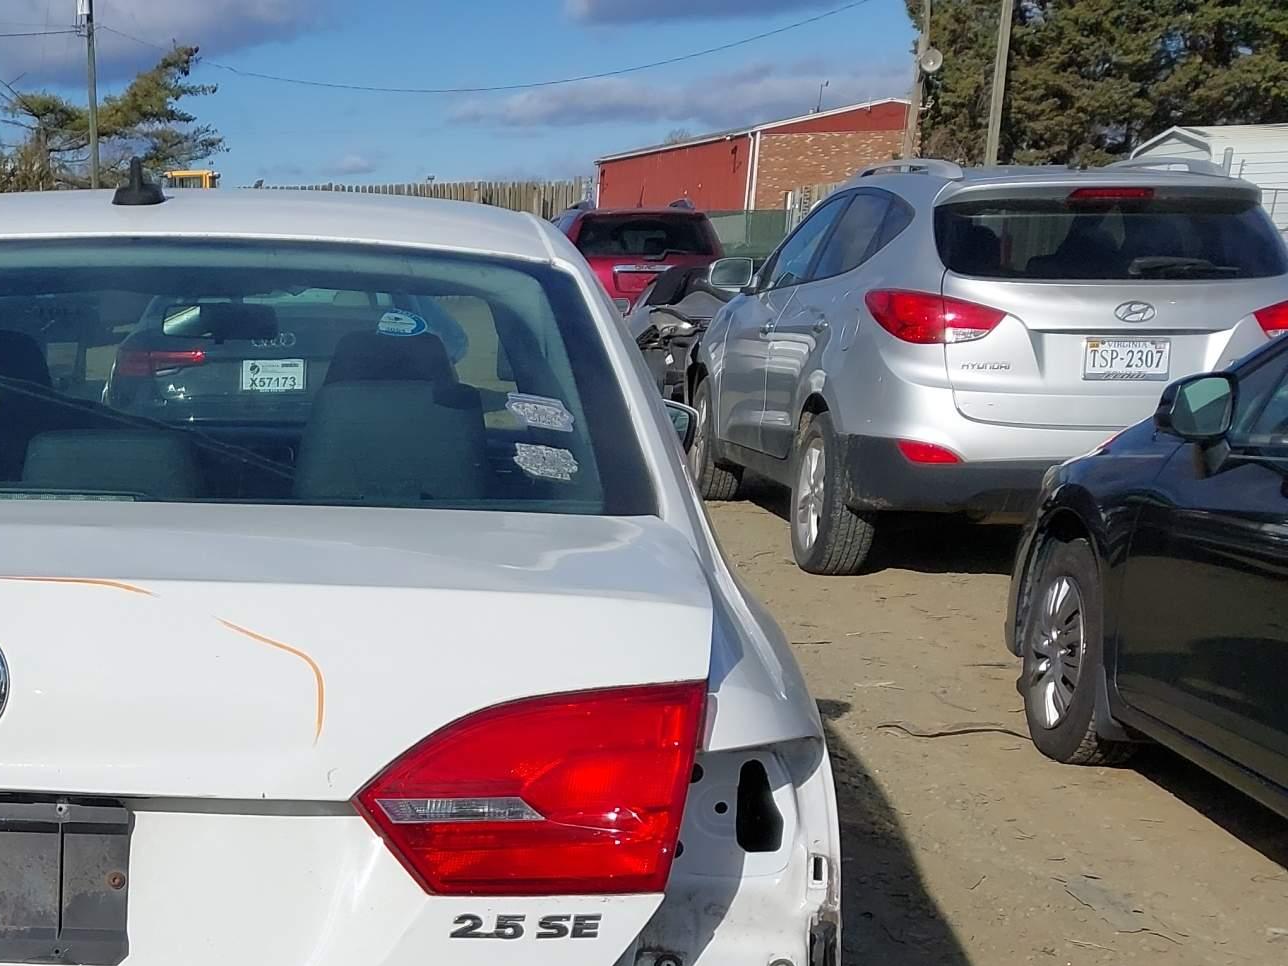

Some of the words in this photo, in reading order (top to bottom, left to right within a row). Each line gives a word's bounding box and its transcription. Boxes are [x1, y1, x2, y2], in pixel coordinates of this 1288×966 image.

[962, 362, 1011, 370] HYUNDAI
[1090, 349, 1164, 368] TSP-2307
[249, 377, 297, 388] X57173
[535, 913, 603, 939] SE
